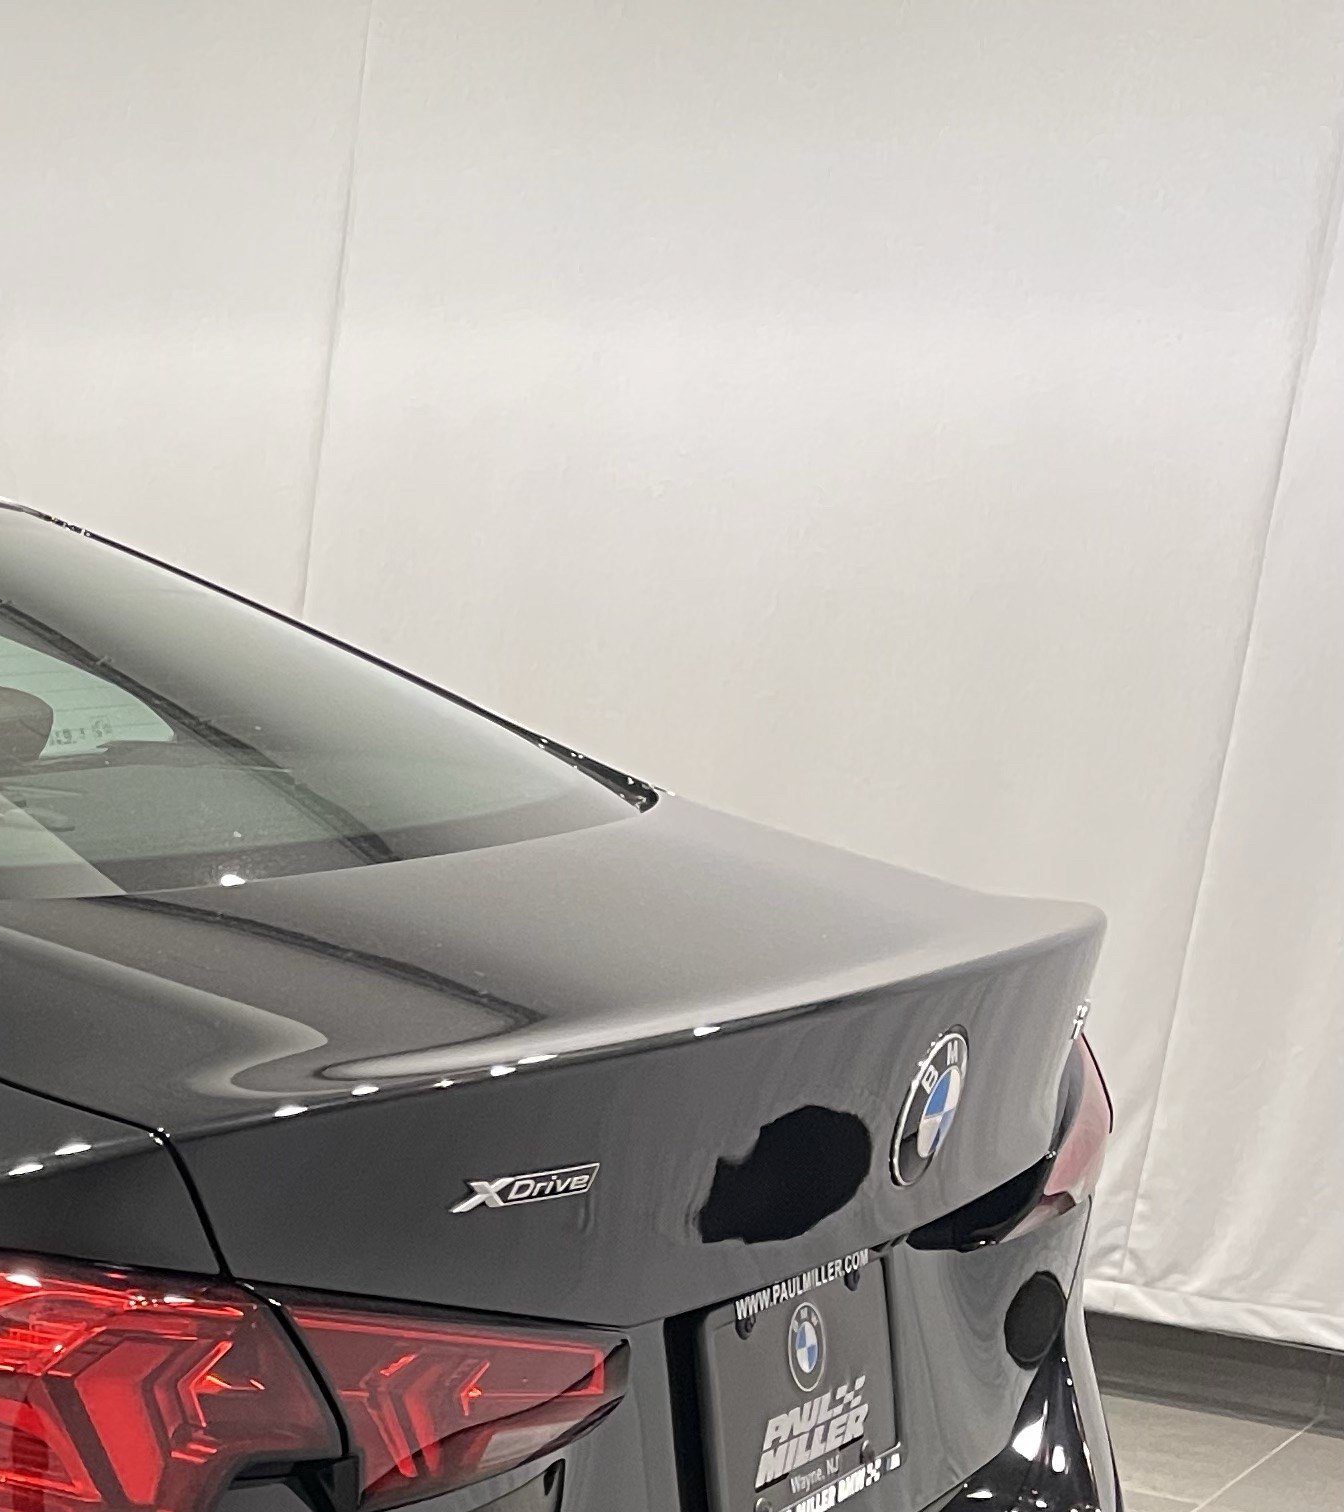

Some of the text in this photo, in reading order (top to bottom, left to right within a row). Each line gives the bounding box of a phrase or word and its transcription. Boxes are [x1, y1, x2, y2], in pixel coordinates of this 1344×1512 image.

[735, 1248, 869, 1320] WWW.PAULMILLER.COM
[755, 1403, 869, 1490] MILLER
[762, 1391, 834, 1453] PAUL
[826, 1454, 840, 1476] NJ
